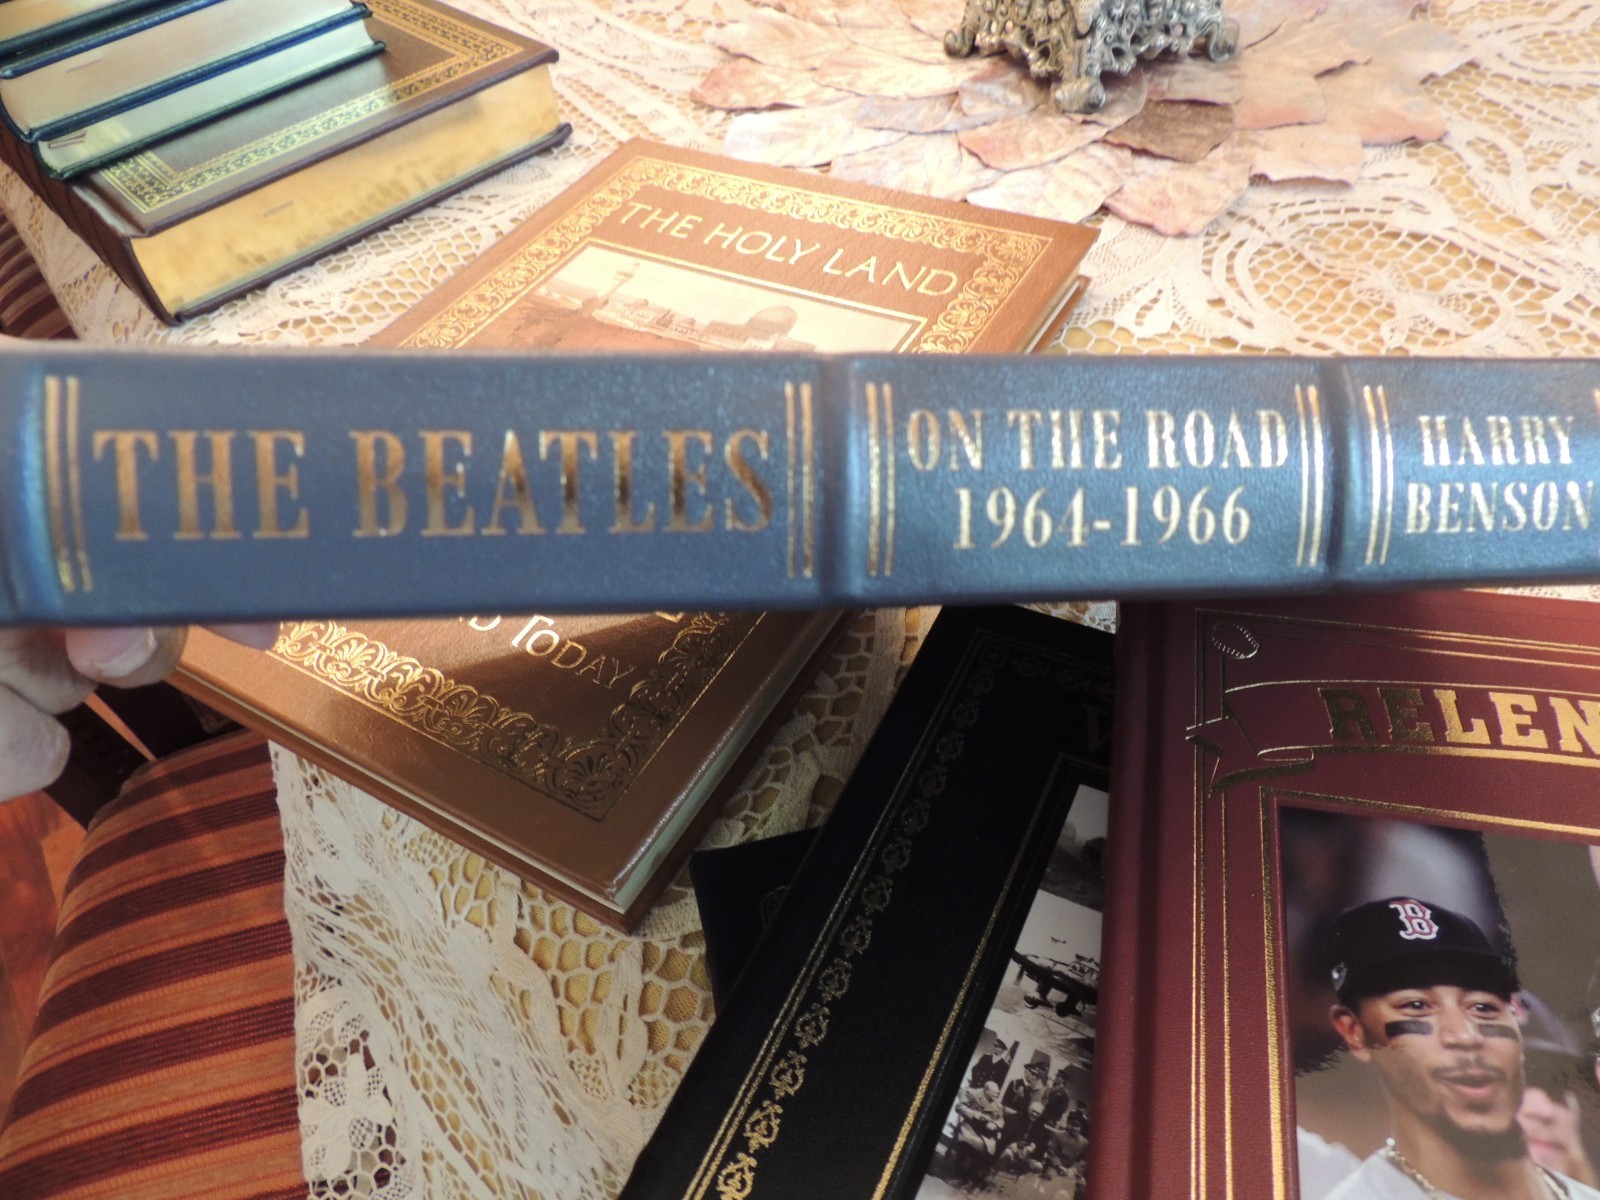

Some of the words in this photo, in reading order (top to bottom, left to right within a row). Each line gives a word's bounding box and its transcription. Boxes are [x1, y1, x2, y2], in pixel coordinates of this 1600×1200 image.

[614, 200, 704, 240] THE
[703, 220, 822, 268] HOLY
[823, 247, 958, 297] LAND
[907, 408, 984, 471] ON
[1007, 409, 1122, 471] THE
[1145, 408, 1290, 470] ROAD
[1418, 415, 1575, 466] HARRY
[92, 429, 310, 542] THE
[349, 428, 774, 538] BEATLES
[1404, 480, 1594, 534] BENSON
[953, 485, 1251, 550] 1964-1966
[511, 615, 637, 690] TODAY
[1389, 899, 1439, 940] B
